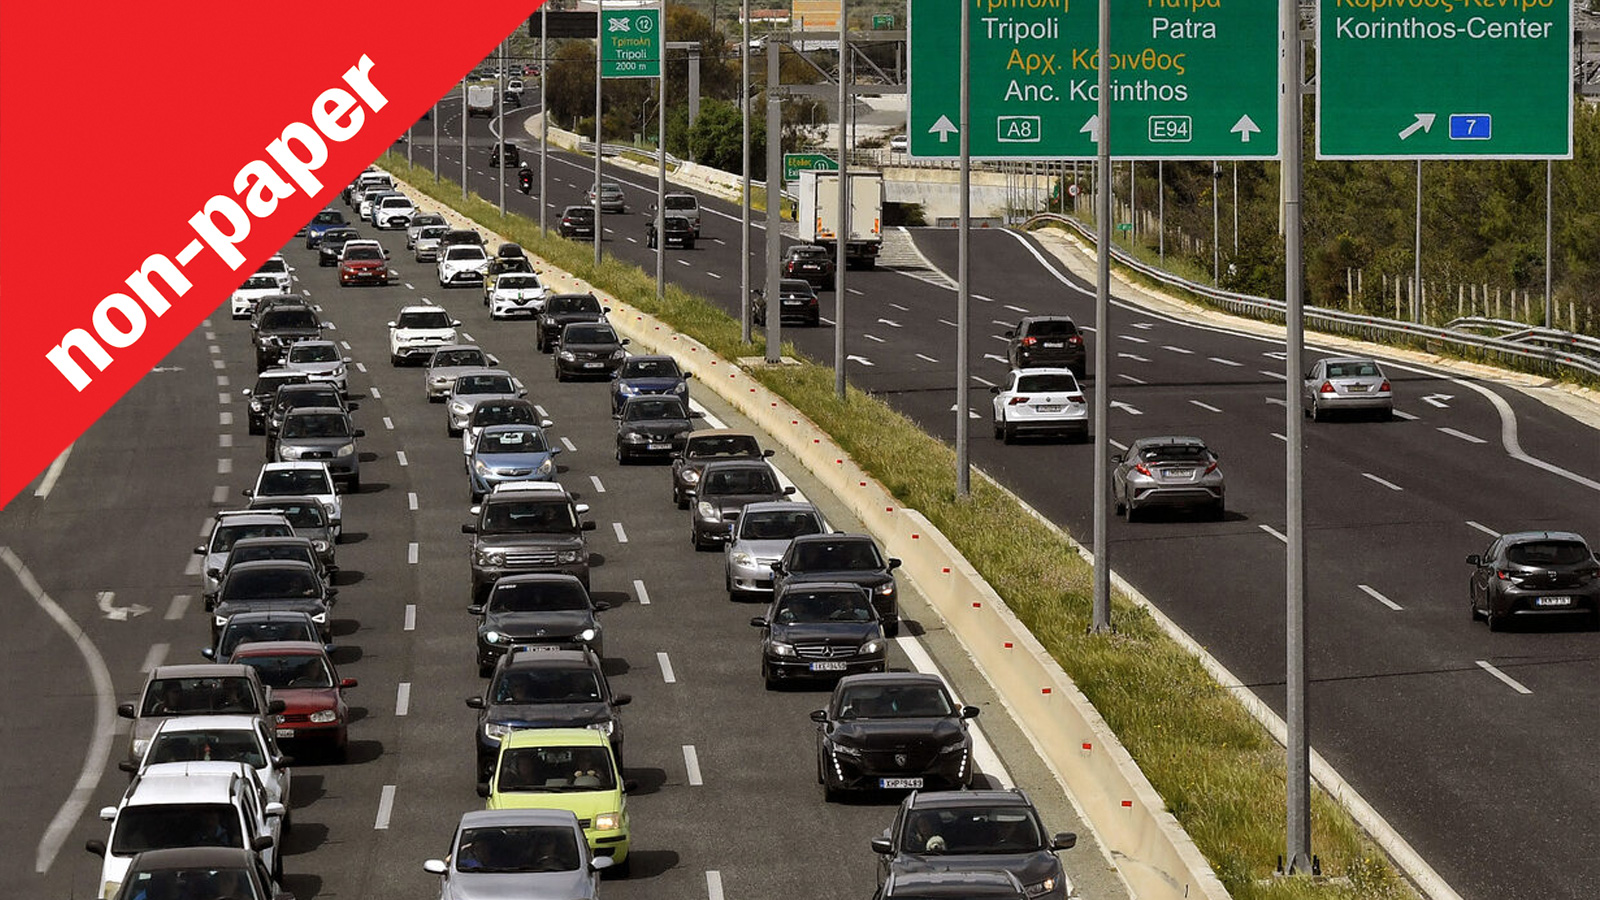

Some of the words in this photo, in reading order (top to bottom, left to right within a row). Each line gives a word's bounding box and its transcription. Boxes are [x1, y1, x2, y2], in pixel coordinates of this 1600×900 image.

[639, 19, 649, 29] 12
[981, 17, 1059, 44] Tripoli
[1152, 17, 1217, 39] Patra
[1336, 16, 1553, 39] Korinthos-Center
[616, 49, 647, 60] Tripoli
[1006, 48, 1062, 75] Αρχ.
[616, 62, 636, 71] 2000
[639, 63, 647, 71] m
[1004, 80, 1060, 101] Anc.
[1070, 79, 1188, 102] Kointhos
[1007, 121, 1032, 137] A8
[1154, 121, 1188, 137] E94
[1465, 119, 1477, 135] 7
